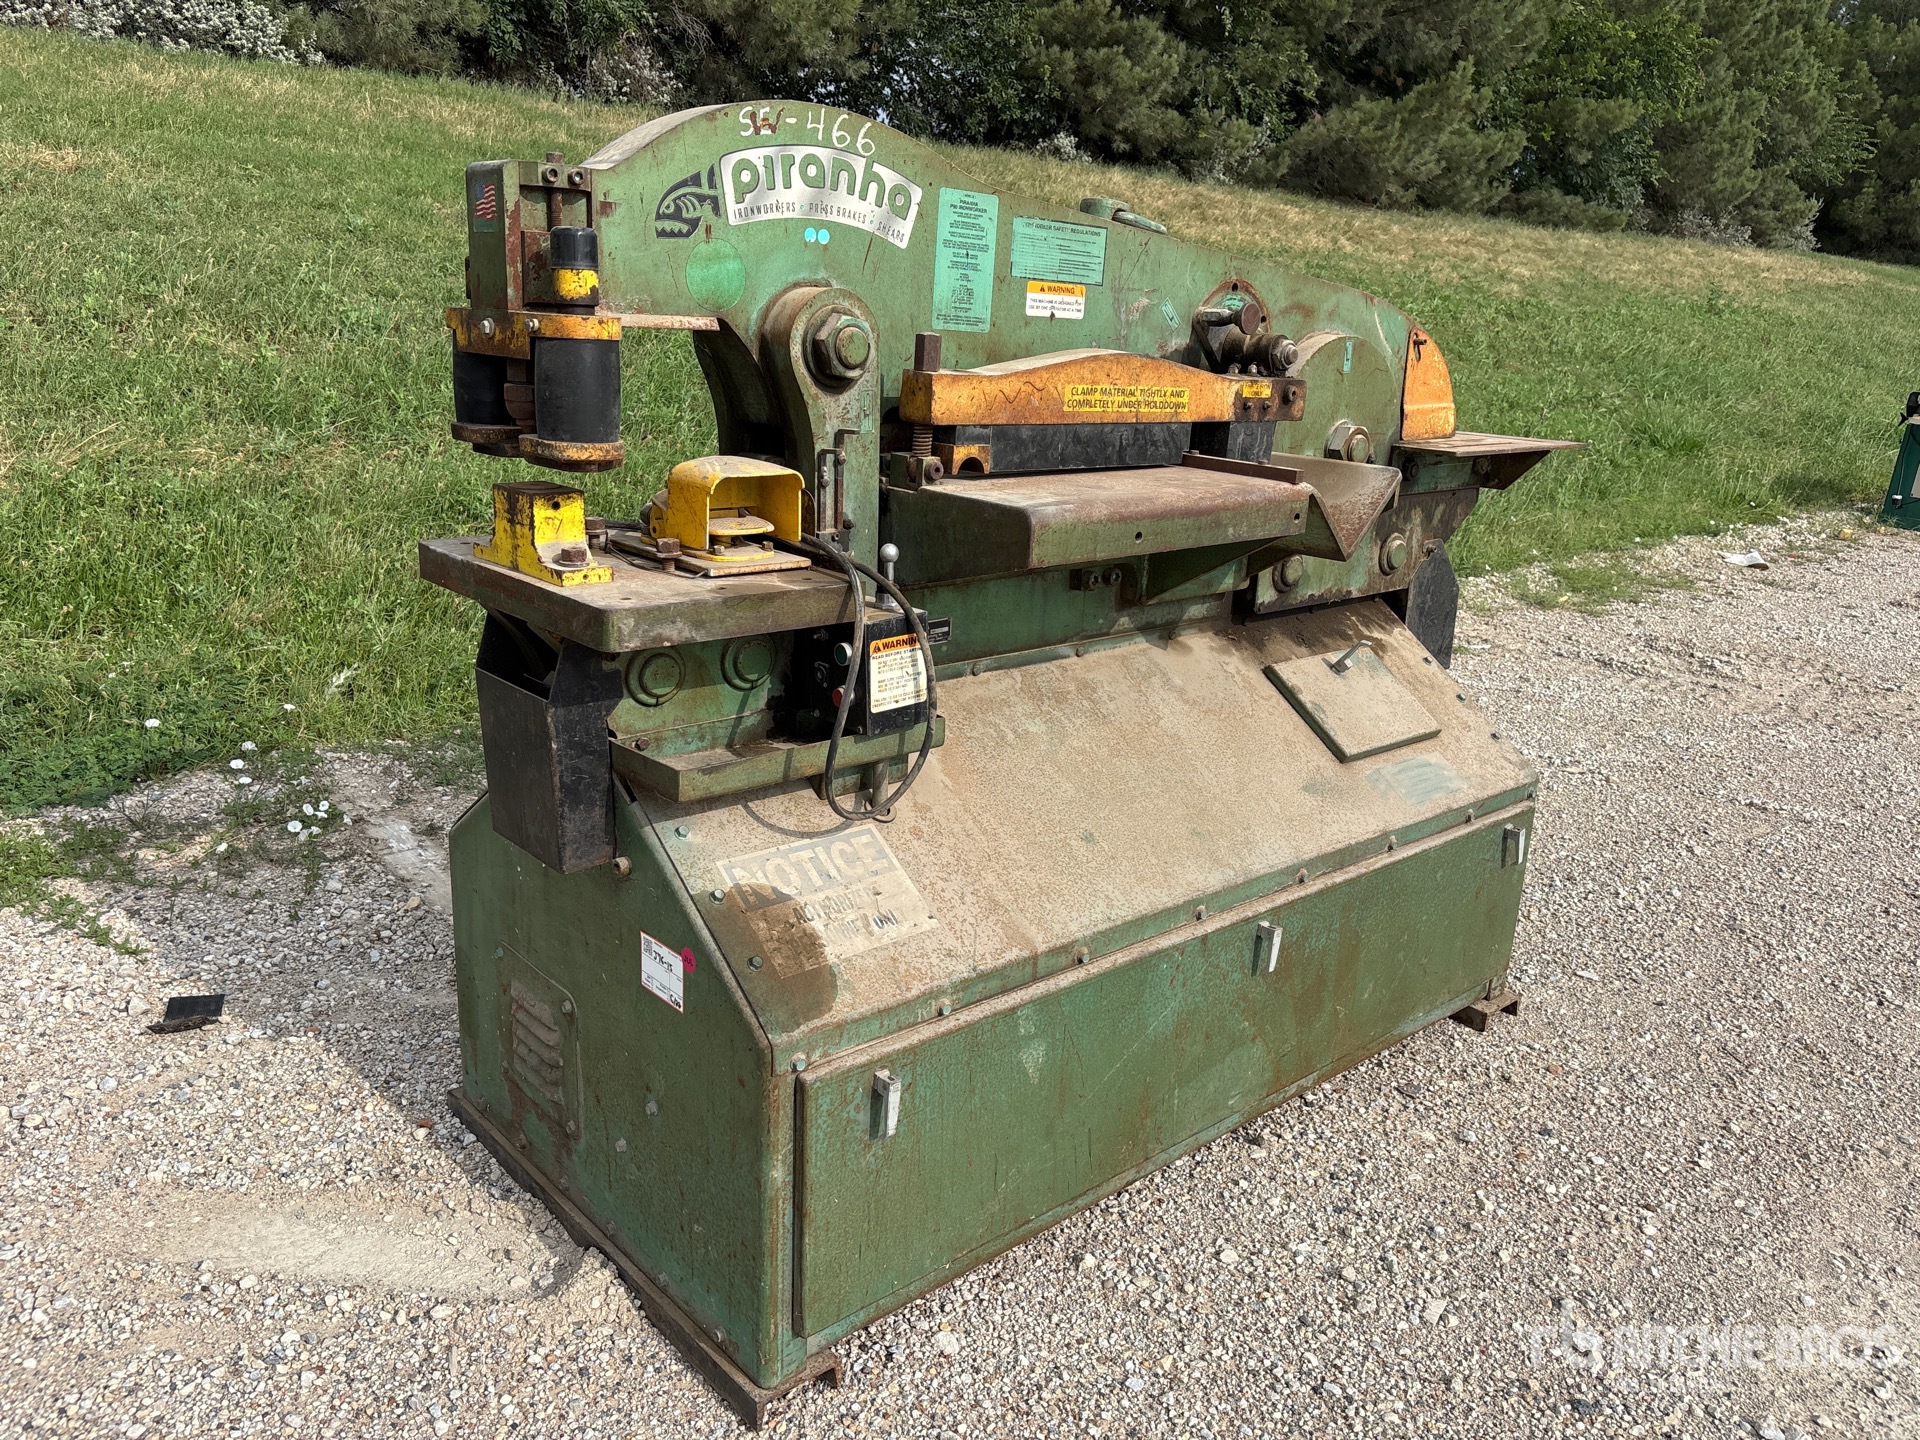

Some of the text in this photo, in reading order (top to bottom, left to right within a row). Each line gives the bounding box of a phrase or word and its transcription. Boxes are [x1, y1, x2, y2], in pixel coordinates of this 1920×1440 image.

[731, 152, 912, 221] piranha
[733, 201, 905, 244] IRONWORKERS PRESS BRAKES SHEARS
[1070, 227, 1101, 237] REGULATIONS
[1047, 285, 1075, 295] WARNING
[1071, 386, 1185, 398] CLAMP MATERIAL TIGHTLY AND
[1066, 399, 1188, 410] COMPLETELY UNDER HOLDDOWN
[882, 636, 917, 650] WARNIN
[885, 650, 902, 658] BEFORE
[731, 833, 890, 906] NOTICE
